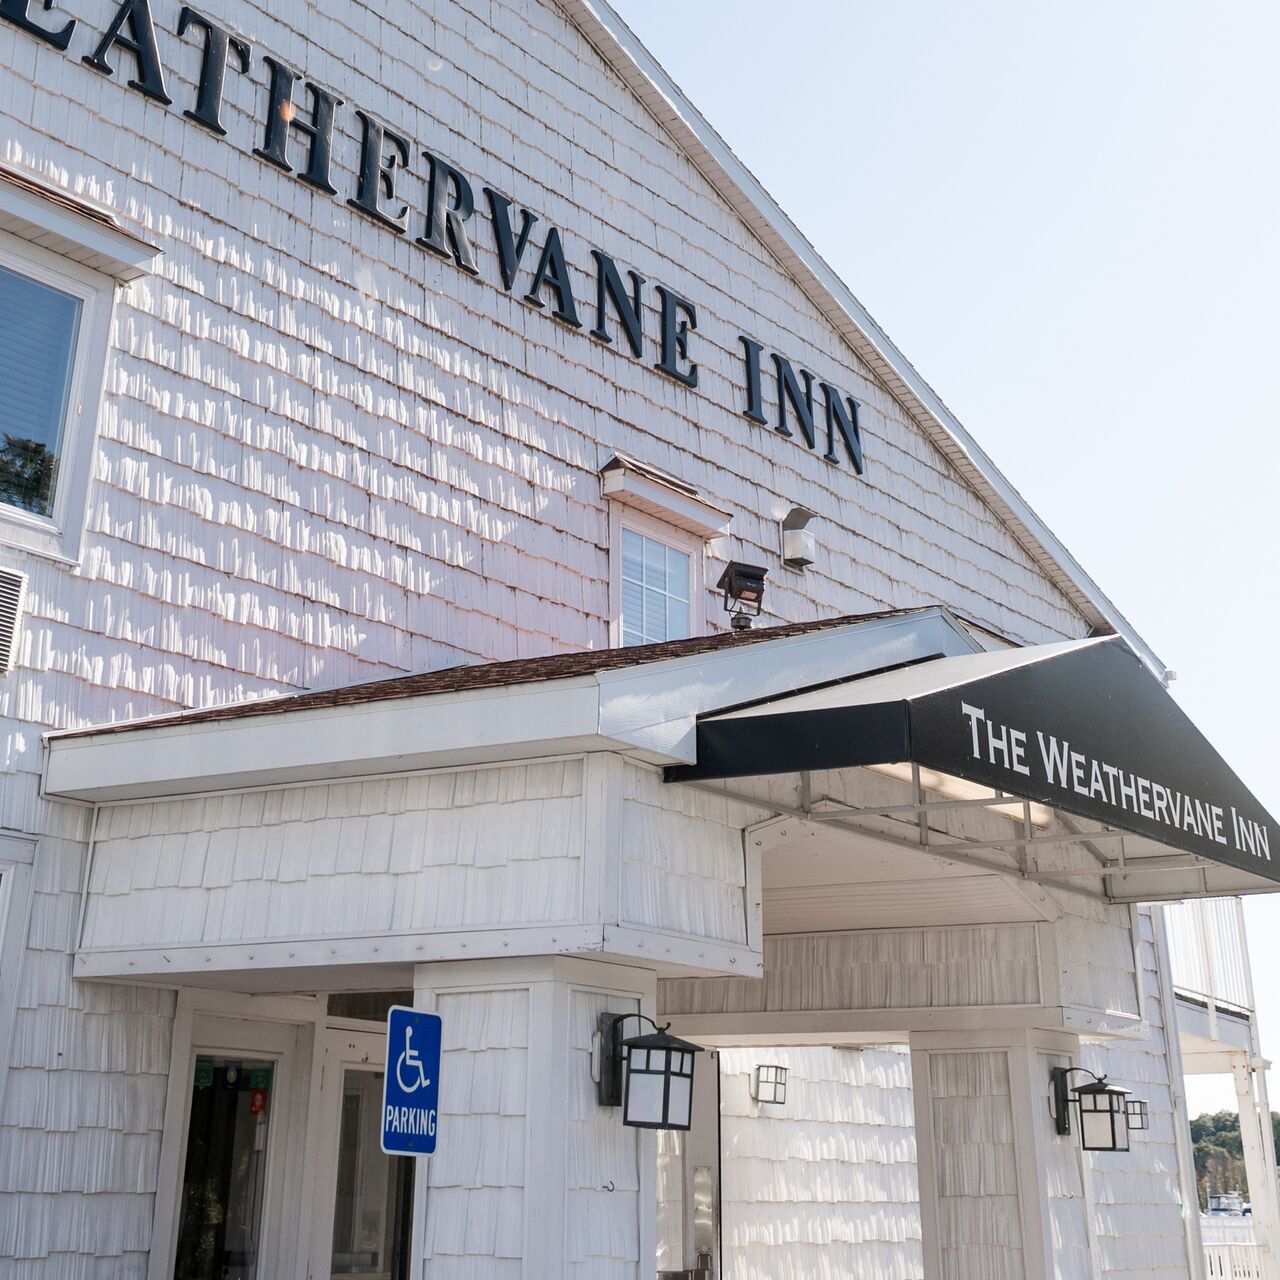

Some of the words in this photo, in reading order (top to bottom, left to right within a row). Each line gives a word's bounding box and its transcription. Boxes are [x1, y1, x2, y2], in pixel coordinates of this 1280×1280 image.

[738, 334, 865, 475] INN
[961, 699, 1030, 777] THE
[1036, 730, 1228, 845] WEATHERVANE
[1230, 806, 1271, 861] INN
[385, 1104, 436, 1137] PARKING
